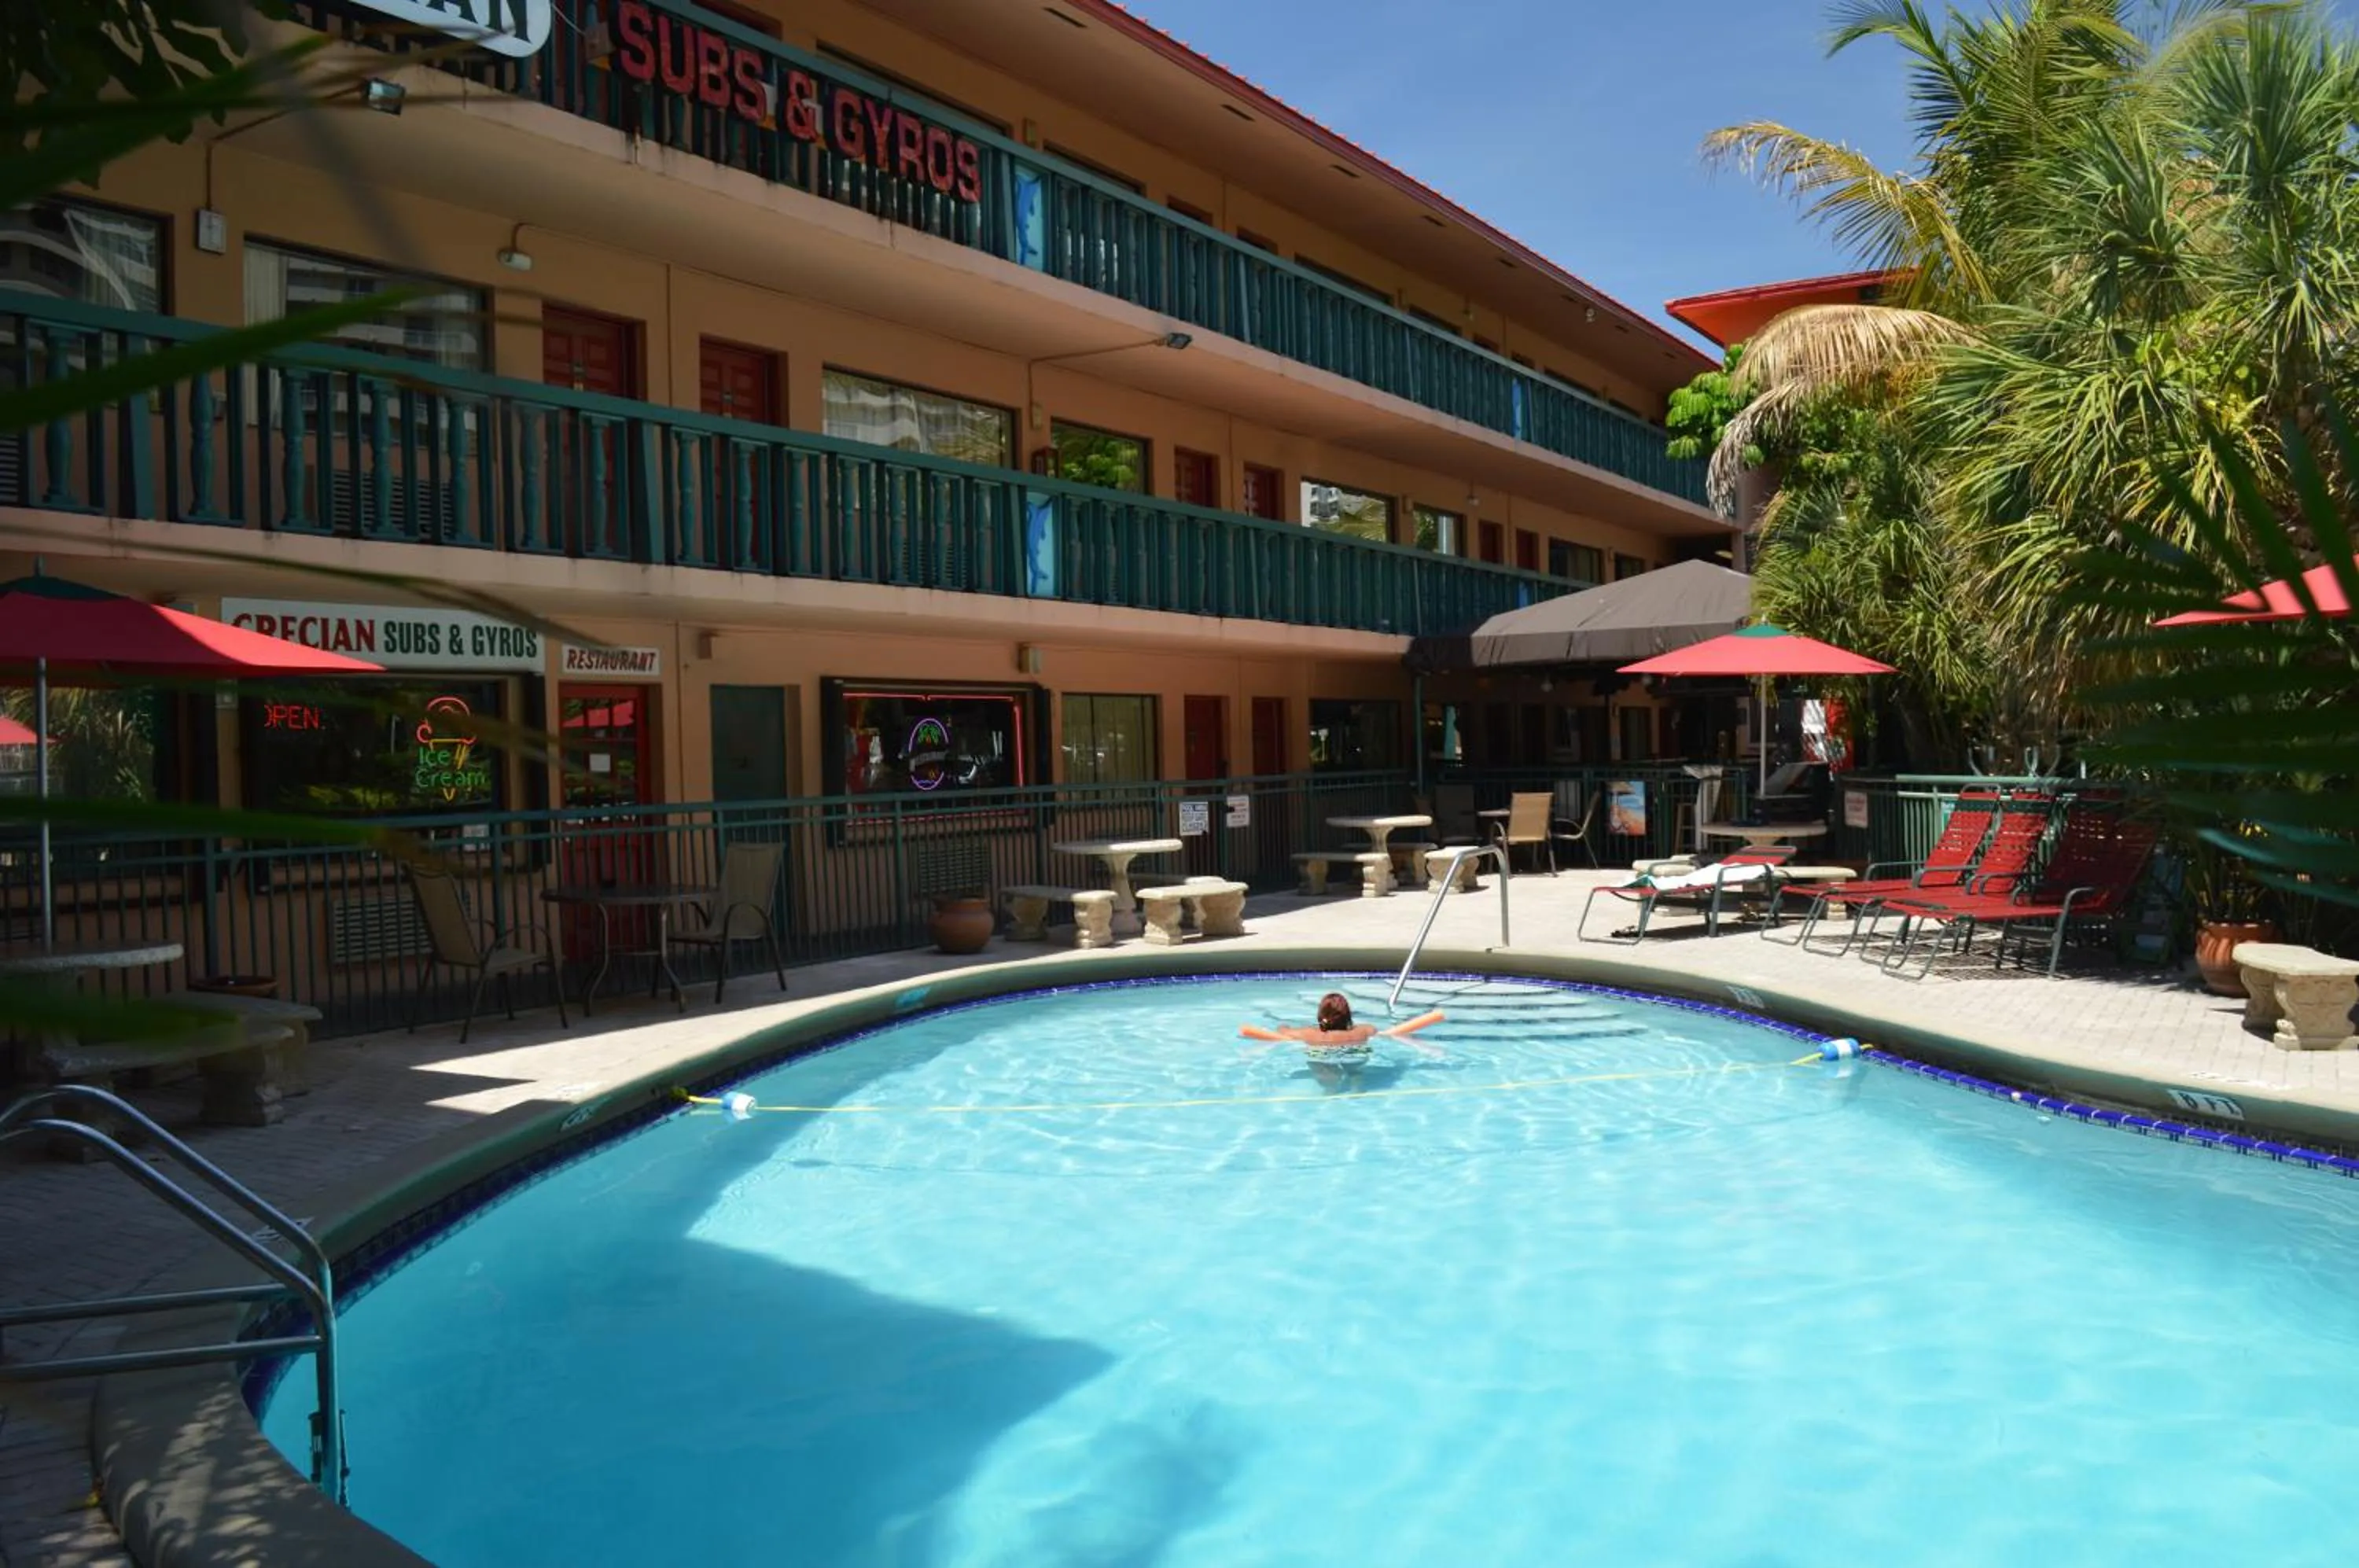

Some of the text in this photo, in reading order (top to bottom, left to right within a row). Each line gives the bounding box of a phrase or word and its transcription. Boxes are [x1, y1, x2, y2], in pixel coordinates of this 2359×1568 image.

[618, 5, 981, 204] SUBS & GYROS
[384, 621, 440, 655] SUBS
[449, 624, 464, 655] &
[473, 625, 537, 658] GYROS
[567, 649, 656, 672] RESTAURANT
[418, 746, 452, 767] Ice
[414, 766, 486, 788] Cream
